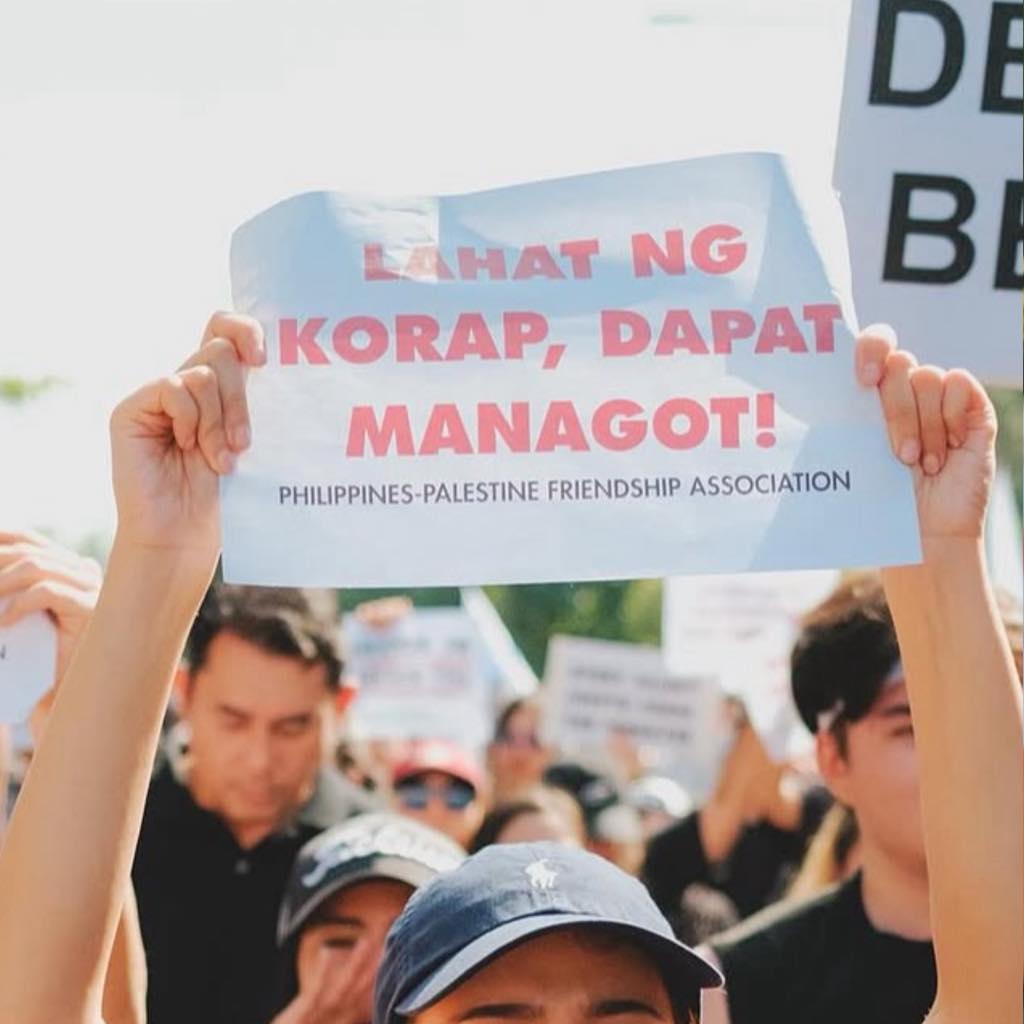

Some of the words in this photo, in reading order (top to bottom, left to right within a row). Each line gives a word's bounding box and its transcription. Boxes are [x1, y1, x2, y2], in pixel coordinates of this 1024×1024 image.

[363, 238, 608, 284] LAHAT
[632, 224, 748, 279] NG
[277, 311, 568, 370] KORAP,
[600, 303, 843, 357] DAPAT
[345, 392, 777, 458] MANAGOT!
[279, 480, 539, 506] PHILIPPINES-PALESTINE
[548, 476, 682, 500] FRIENDSHIP
[690, 470, 851, 496] ASSOCIATION
